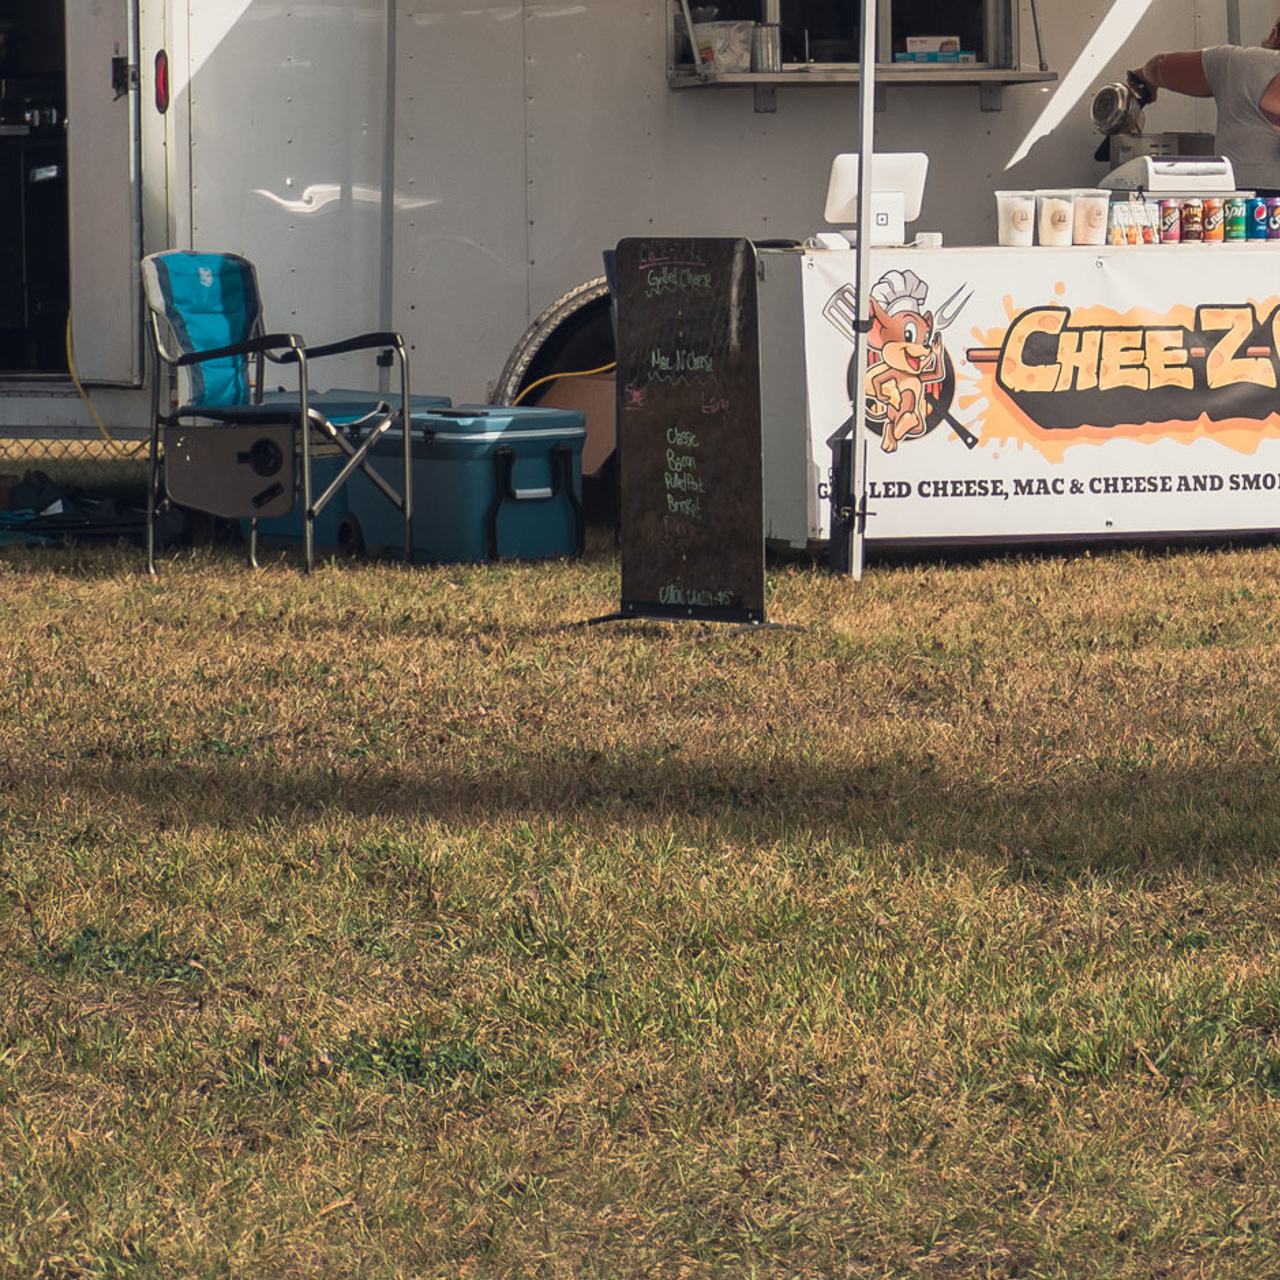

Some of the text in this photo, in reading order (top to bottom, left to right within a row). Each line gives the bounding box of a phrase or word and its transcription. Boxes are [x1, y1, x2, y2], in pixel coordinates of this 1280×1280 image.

[666, 427, 699, 447] Classic
[666, 448, 696, 471] Bacon
[817, 481, 912, 499] GLED
[917, 478, 1009, 500] CHEESE,
[1013, 477, 1065, 496] MAC
[1070, 478, 1085, 495] &
[1089, 475, 1173, 494] CHEESE
[1176, 474, 1224, 492] AND
